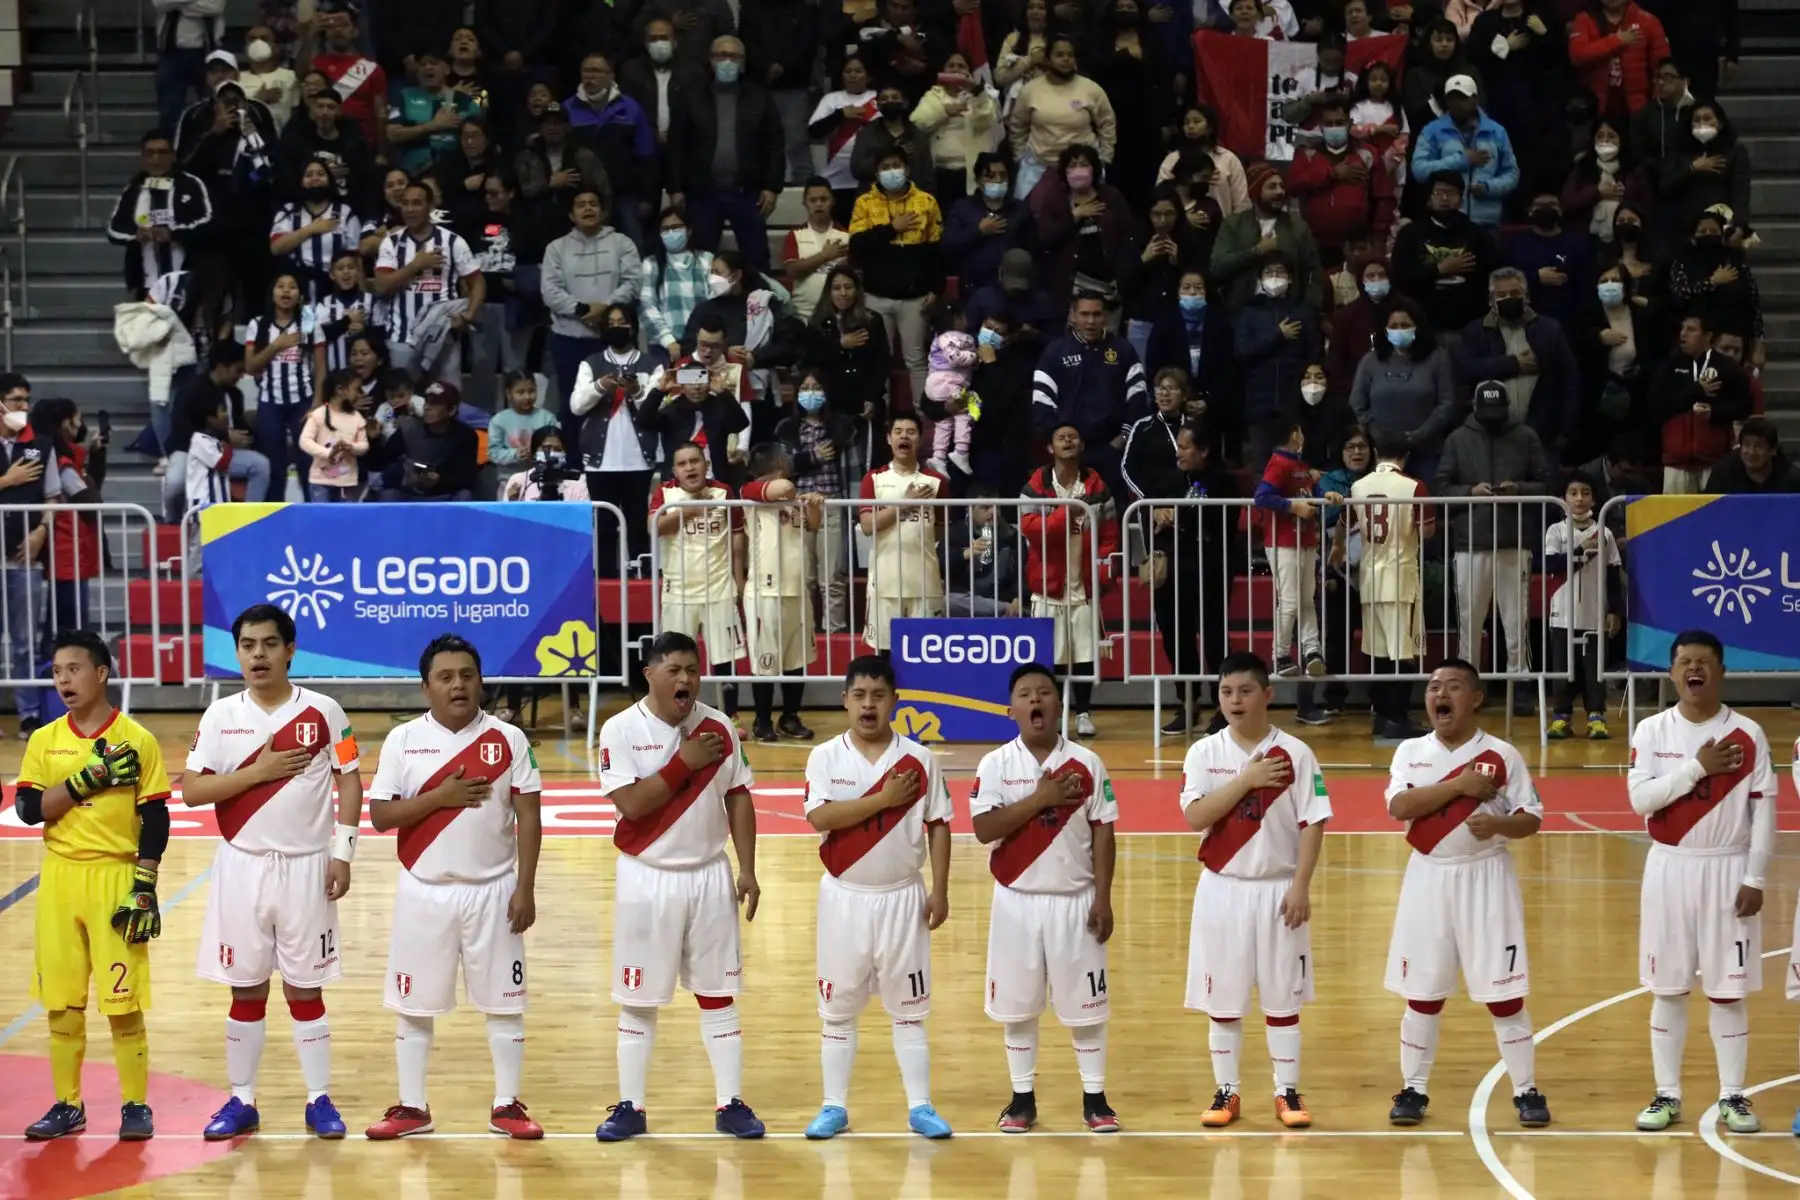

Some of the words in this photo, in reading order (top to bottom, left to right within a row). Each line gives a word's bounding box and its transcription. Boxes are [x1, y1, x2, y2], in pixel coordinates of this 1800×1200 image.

[354, 600, 448, 624] Seguimos
[453, 599, 529, 623] jugando
[46, 748, 79, 756] marathon
[320, 928, 335, 959] 12
[512, 960, 524, 986] 8
[1505, 944, 1517, 973] 7
[110, 962, 129, 993] 2
[908, 969, 925, 998] 11
[1087, 968, 1107, 997] 14
[1492, 973, 1526, 985] marathon
